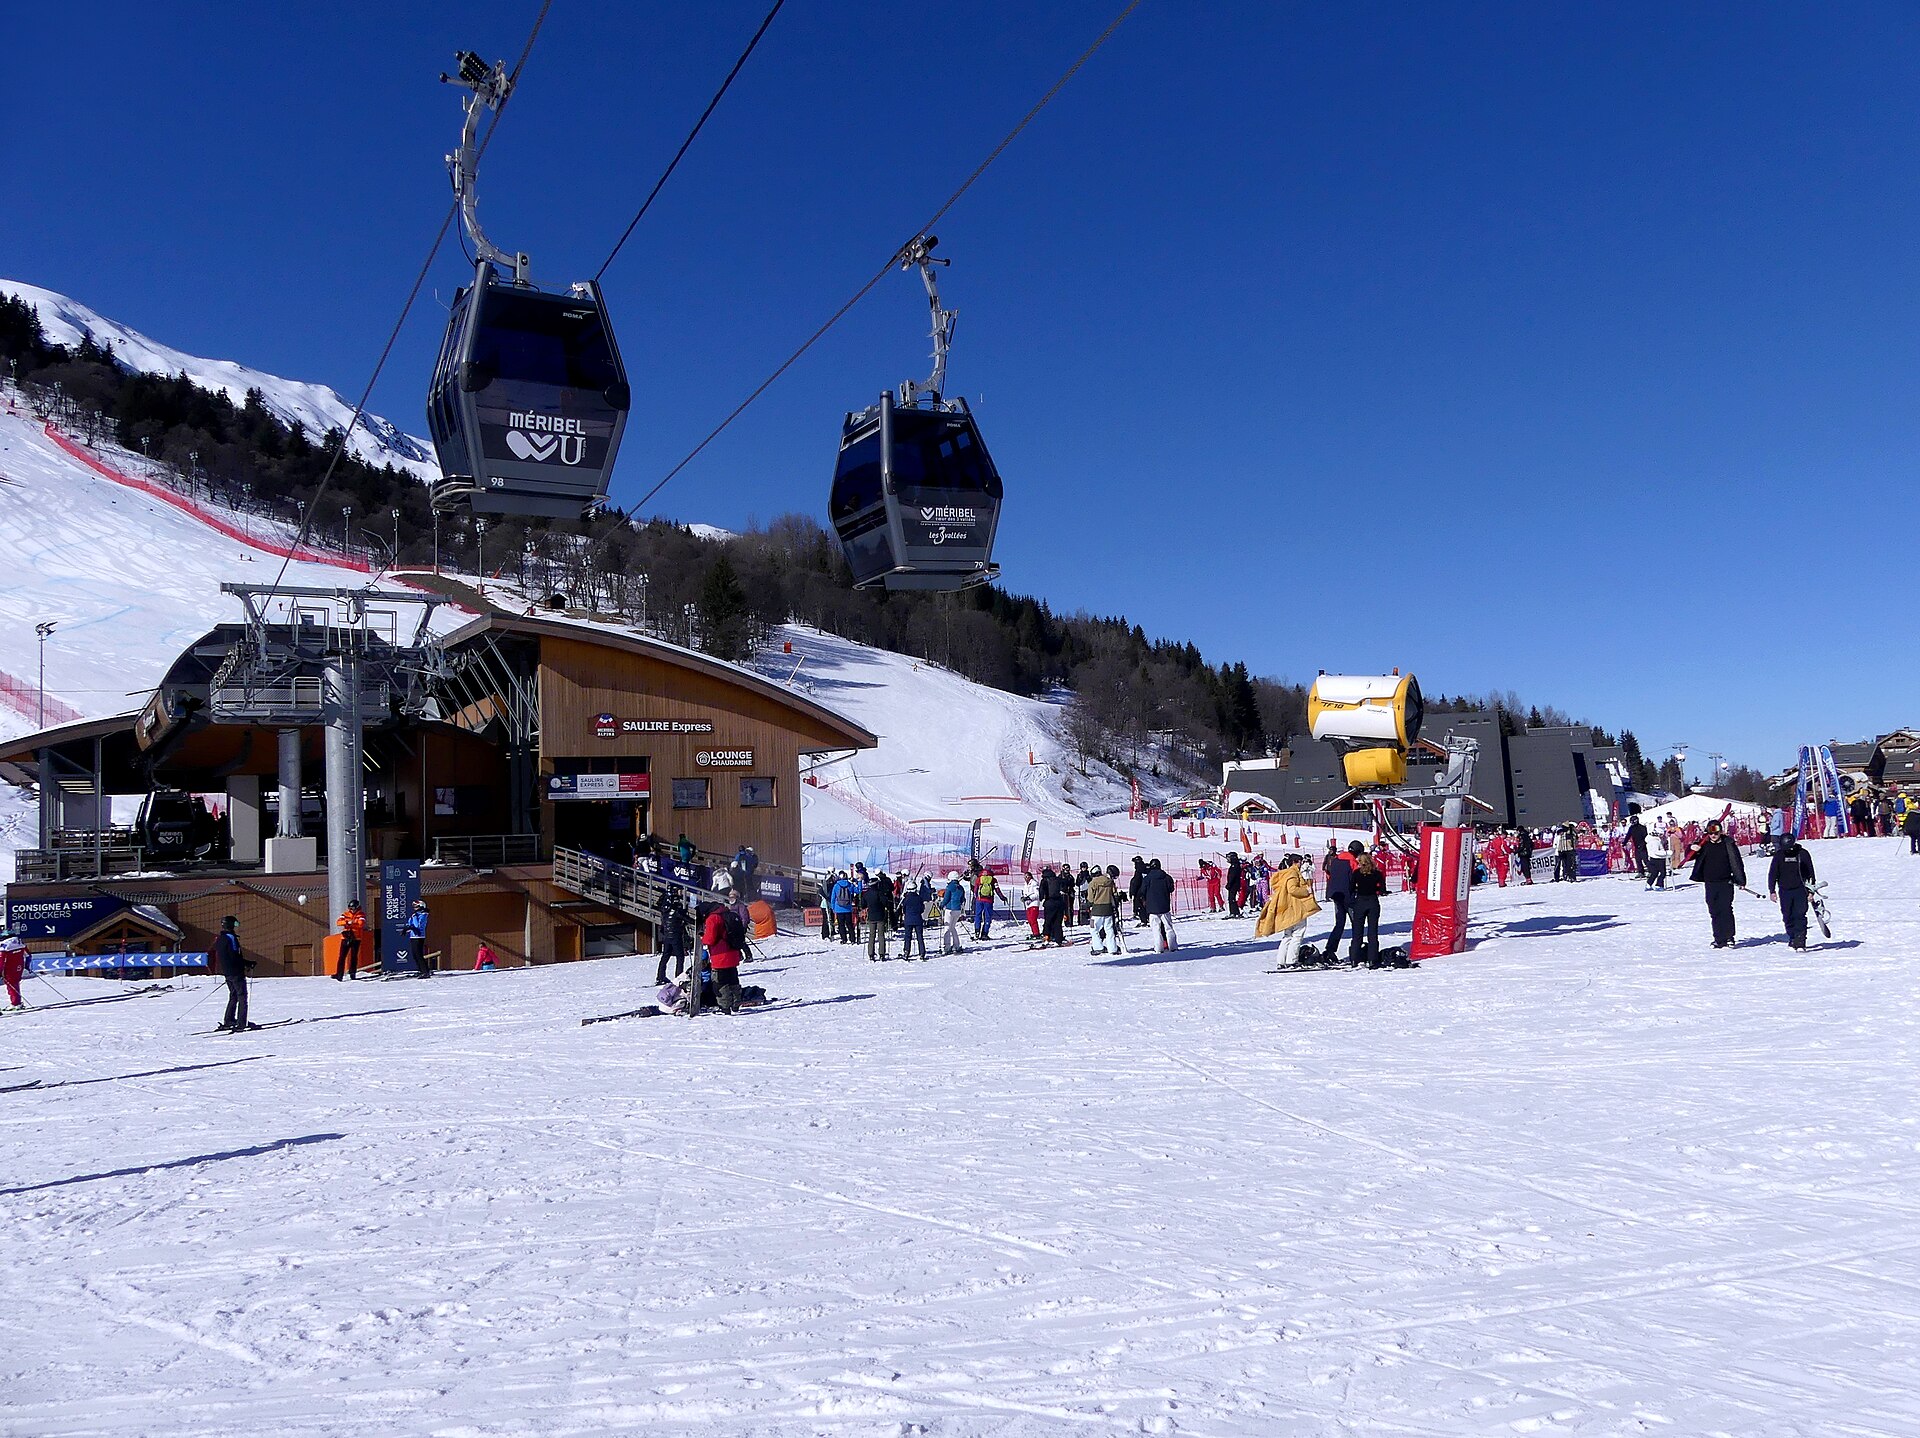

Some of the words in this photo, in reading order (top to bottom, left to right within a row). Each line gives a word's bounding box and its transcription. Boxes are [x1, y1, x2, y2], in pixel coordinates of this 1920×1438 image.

[509, 410, 586, 435] MÉRIBEL
[559, 435, 586, 465] U
[491, 477, 504, 487] 98
[935, 505, 976, 518] MÉRIBEL
[974, 561, 983, 569] 79
[623, 721, 669, 731] SAULIRE
[672, 721, 712, 732] Express
[710, 751, 752, 759] LOUNGE
[1531, 855, 1556, 869] ÉRIBE
[12, 903, 61, 912] CONSIGNE
[63, 902, 70, 910] A
[71, 901, 93, 910] SKIS
[12, 912, 27, 920] SKI
[28, 910, 72, 919] LOCKERS
